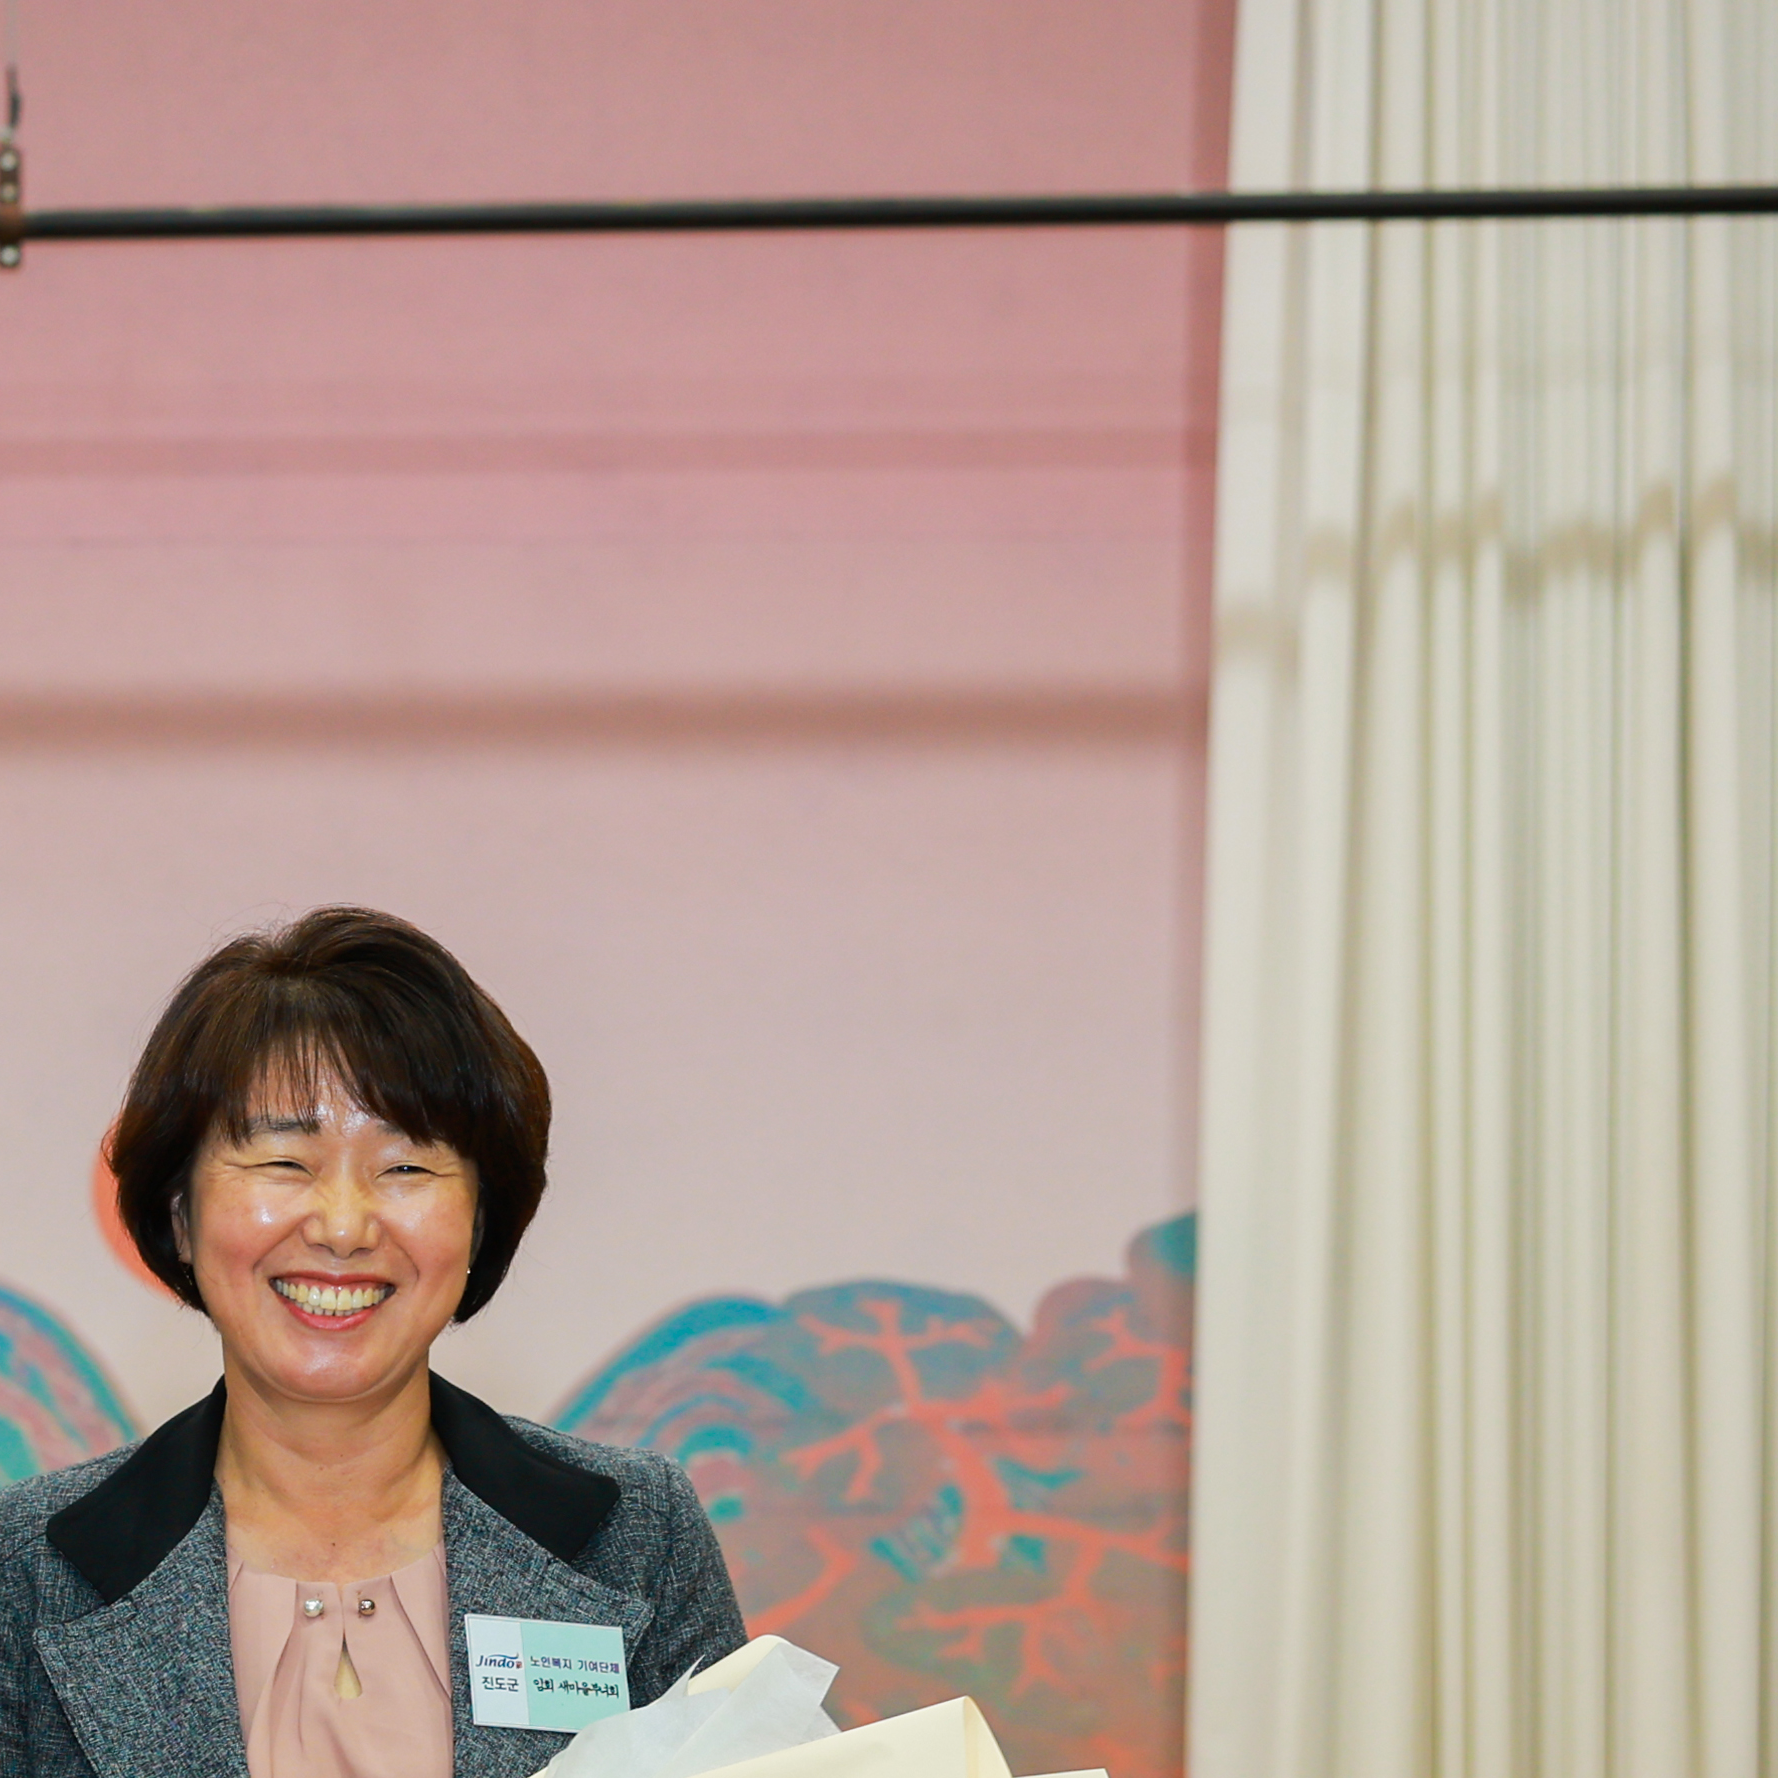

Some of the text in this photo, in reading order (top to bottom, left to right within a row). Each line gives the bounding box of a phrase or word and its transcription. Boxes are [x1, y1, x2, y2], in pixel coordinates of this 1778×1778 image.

[475, 1654, 515, 1668] Jindo
[530, 1656, 620, 1674] 노인복지 기여단체
[482, 1676, 519, 1692] 진도군
